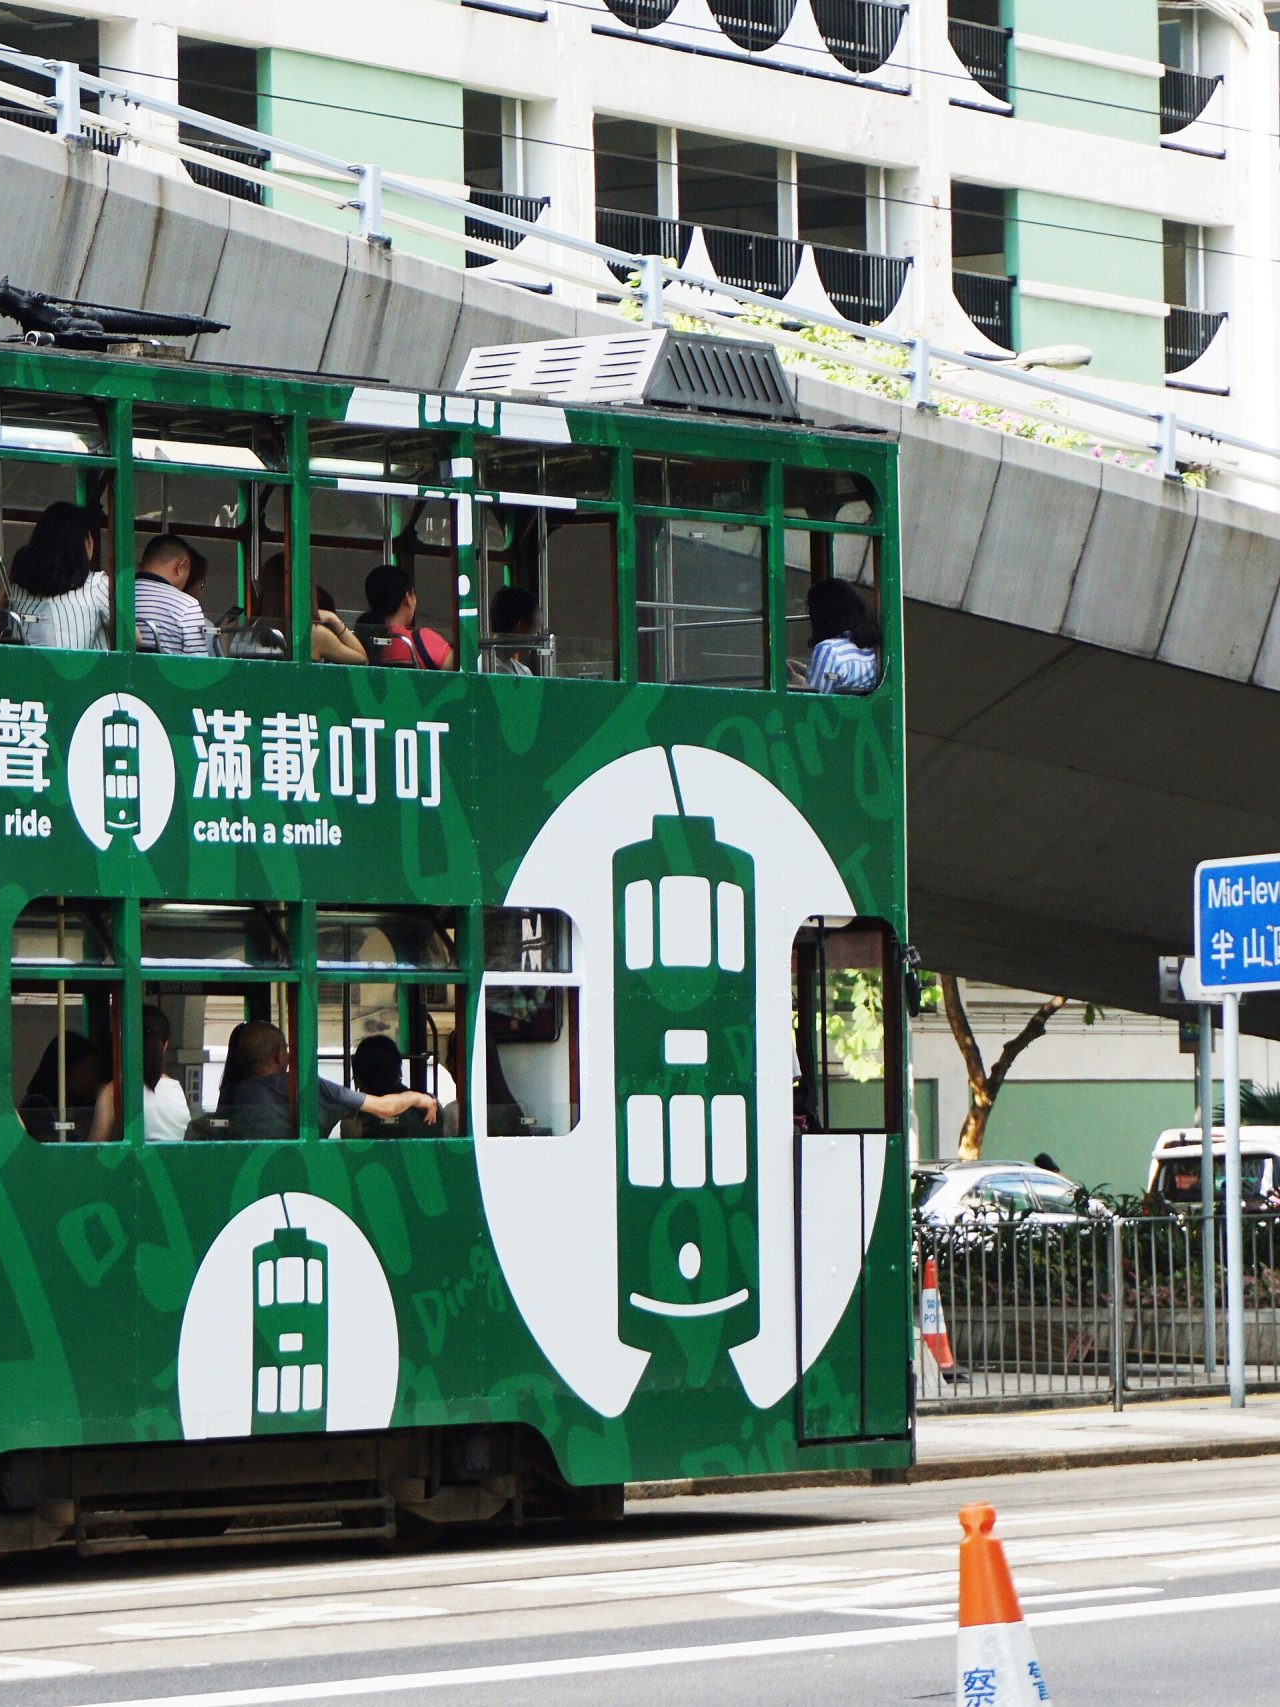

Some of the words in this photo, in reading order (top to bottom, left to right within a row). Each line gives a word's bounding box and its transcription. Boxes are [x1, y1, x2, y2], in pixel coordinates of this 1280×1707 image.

[192, 708, 449, 807] 滿載叮叮
[5, 808, 51, 837] ride
[193, 816, 255, 843] catch
[263, 823, 276, 844] a
[283, 819, 342, 846] smile
[963, 1667, 997, 1707] 察
